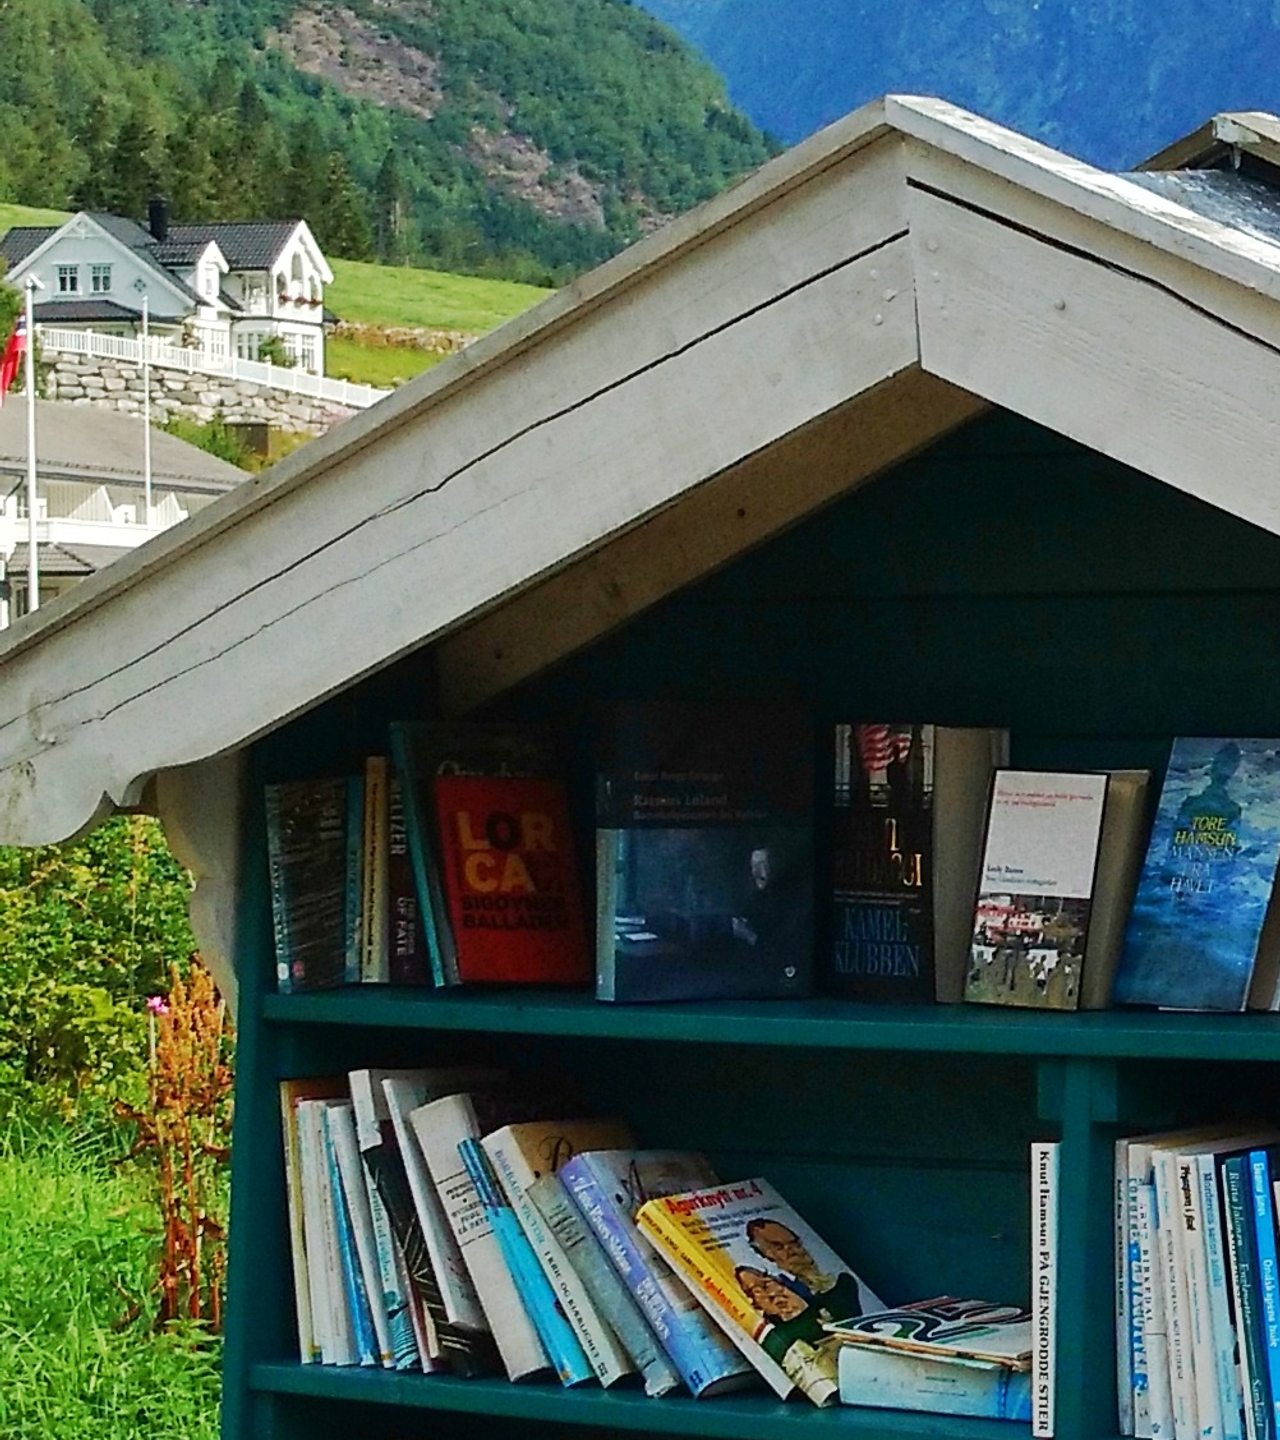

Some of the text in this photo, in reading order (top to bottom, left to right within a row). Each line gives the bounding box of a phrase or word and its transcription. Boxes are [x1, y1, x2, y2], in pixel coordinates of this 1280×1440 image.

[456, 810, 556, 851] LOR
[1174, 831, 1237, 846] HAMSUN
[1191, 816, 1228, 831] TORE
[465, 852, 536, 893] CA
[834, 941, 920, 977] KLUBBEN
[750, 1179, 762, 1196] 4
[519, 1202, 548, 1244] VICTOR
[558, 1281, 571, 1297] OG
[1038, 1151, 1052, 1431] Knut Hamsun PÅ GJENGRODDE STIER
[1259, 1258, 1279, 1322] Ondskapens
[1267, 1324, 1279, 1348] hule
